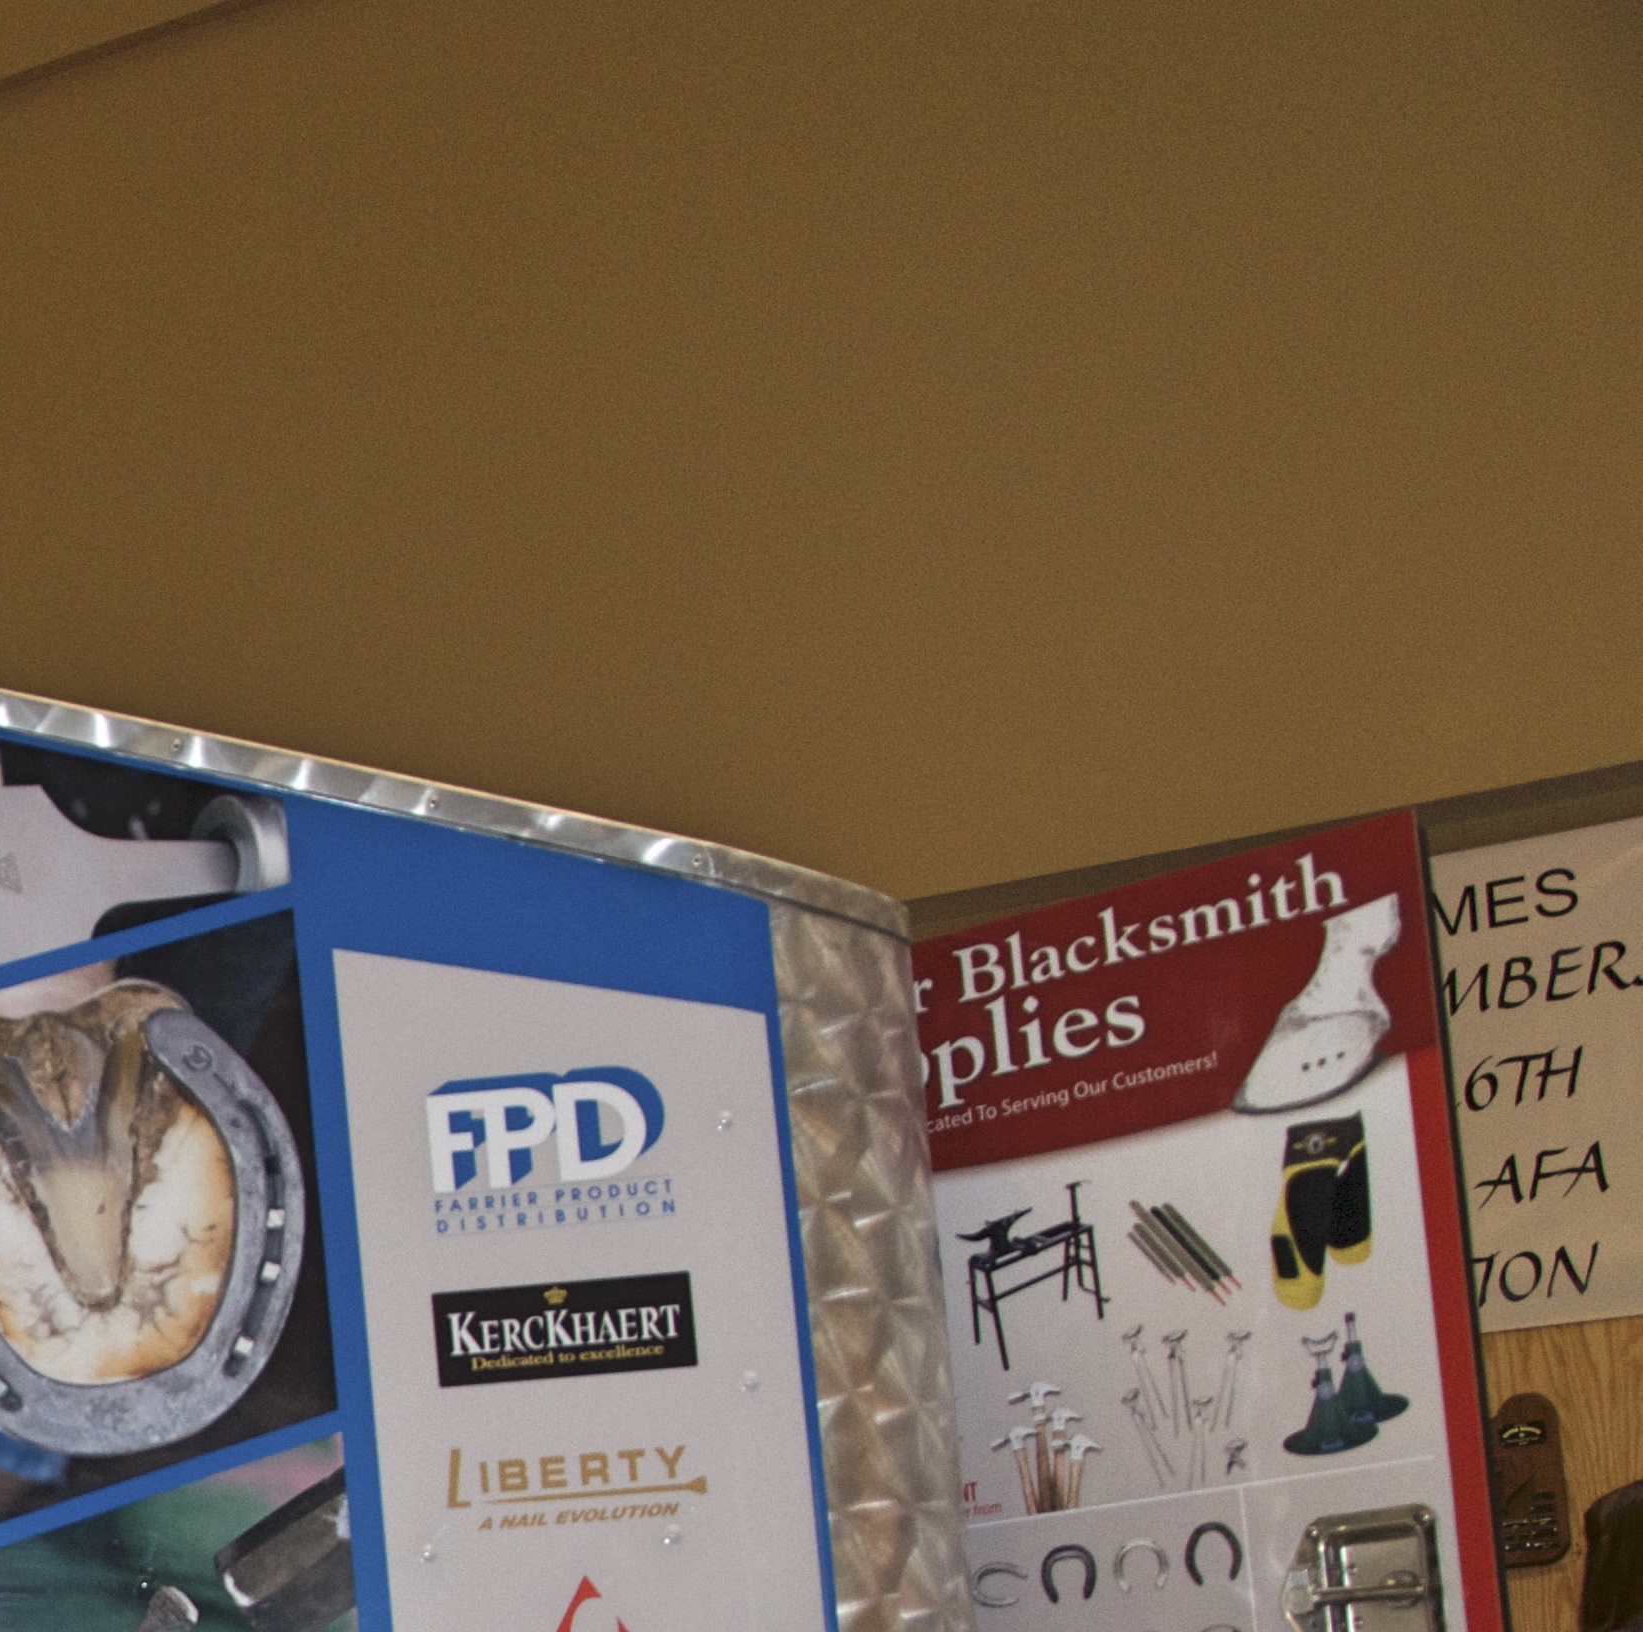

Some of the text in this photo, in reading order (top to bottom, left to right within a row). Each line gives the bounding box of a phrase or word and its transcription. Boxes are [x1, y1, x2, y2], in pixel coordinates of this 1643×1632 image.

[952, 851, 1349, 1004] Blacksmith
[918, 992, 1148, 1110] plies
[1460, 1045, 1584, 1112] 6TH
[926, 1050, 1220, 1135] cated To Serving Our Customers!
[425, 1072, 658, 1194] FPD
[434, 1178, 674, 1214] FARRIER PRODUCT
[1473, 1140, 1610, 1211] AFA
[436, 1199, 677, 1234] DISTRIBUTION
[471, 1343, 665, 1373] Dedicated to excellence
[447, 1444, 687, 1509] LIBERTY
[973, 1502, 1003, 1517] from
[478, 1501, 681, 1530] A NAIL EVOLUTION
